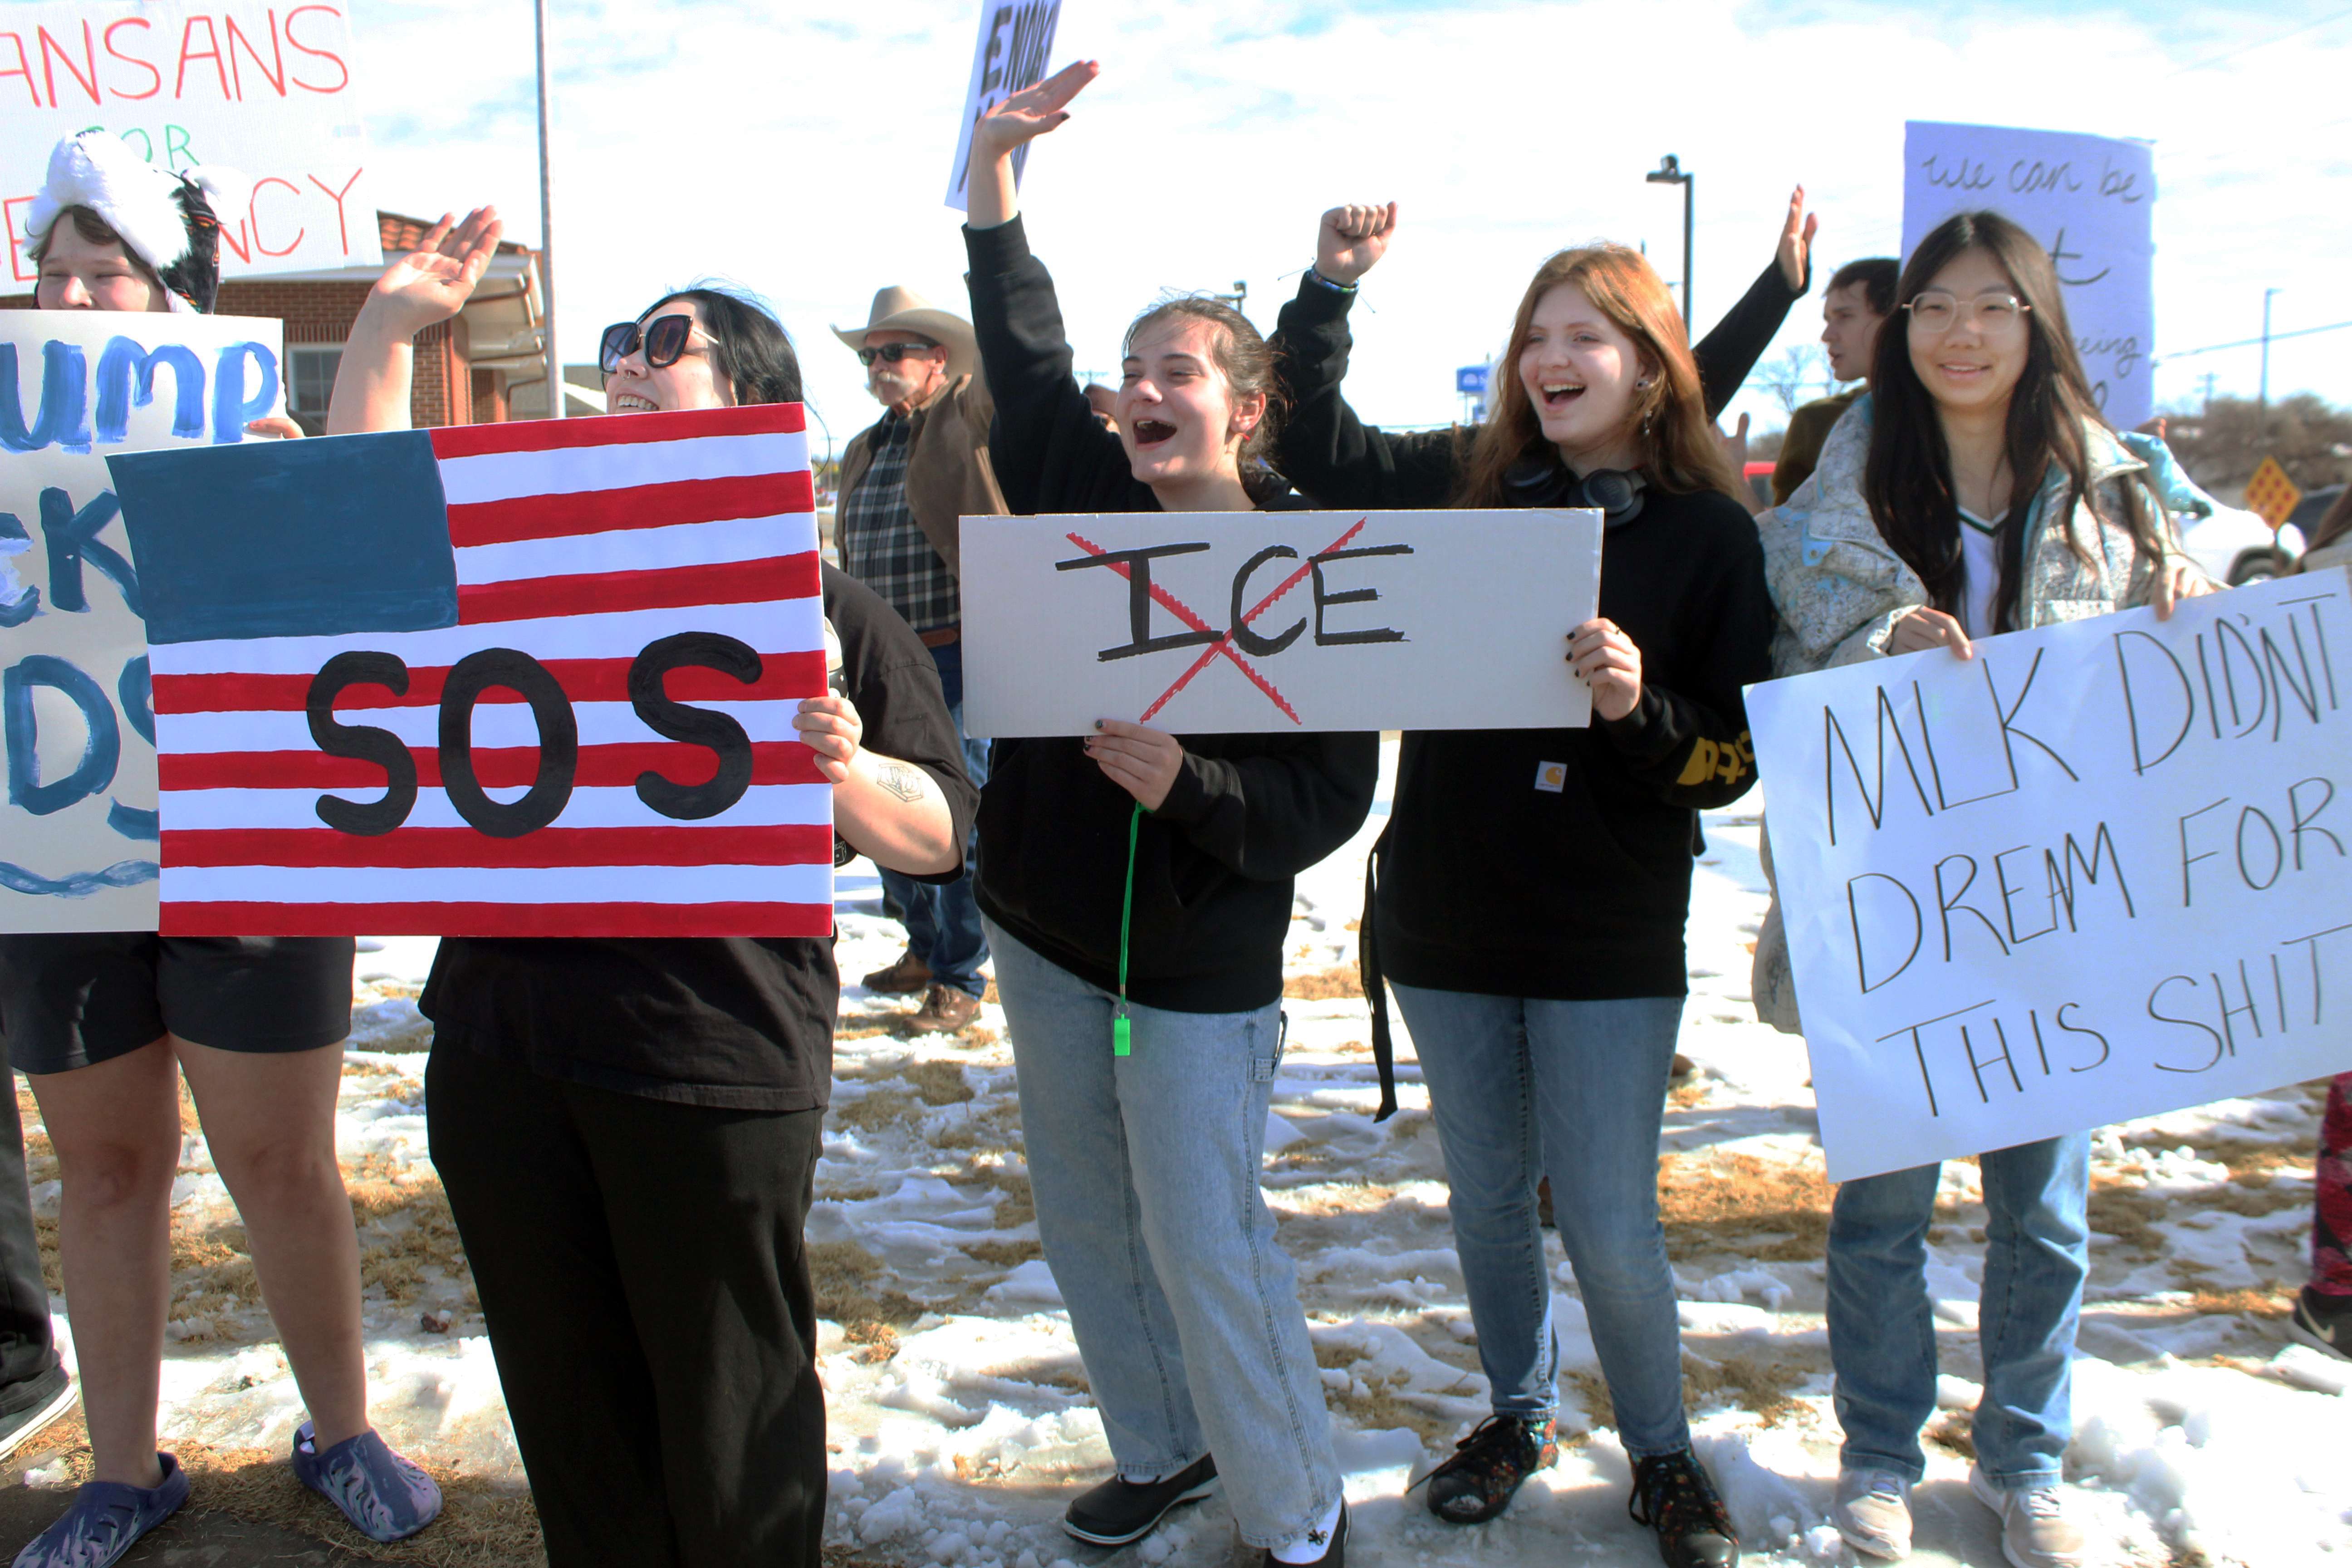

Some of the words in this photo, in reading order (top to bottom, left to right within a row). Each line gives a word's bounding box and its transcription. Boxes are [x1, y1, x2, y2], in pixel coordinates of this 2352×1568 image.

[75, 123, 200, 170] OR
[2009, 159, 2082, 193] can
[2098, 156, 2145, 204] be
[1055, 541, 1415, 662] ICE
[306, 631, 763, 838] SOS
[1825, 647, 2080, 847] MLK
[1847, 821, 2136, 994] DREAM
[2180, 776, 2347, 908] FOR
[1876, 998, 2110, 1117] THIS
[2148, 923, 2352, 1073] SHIT
